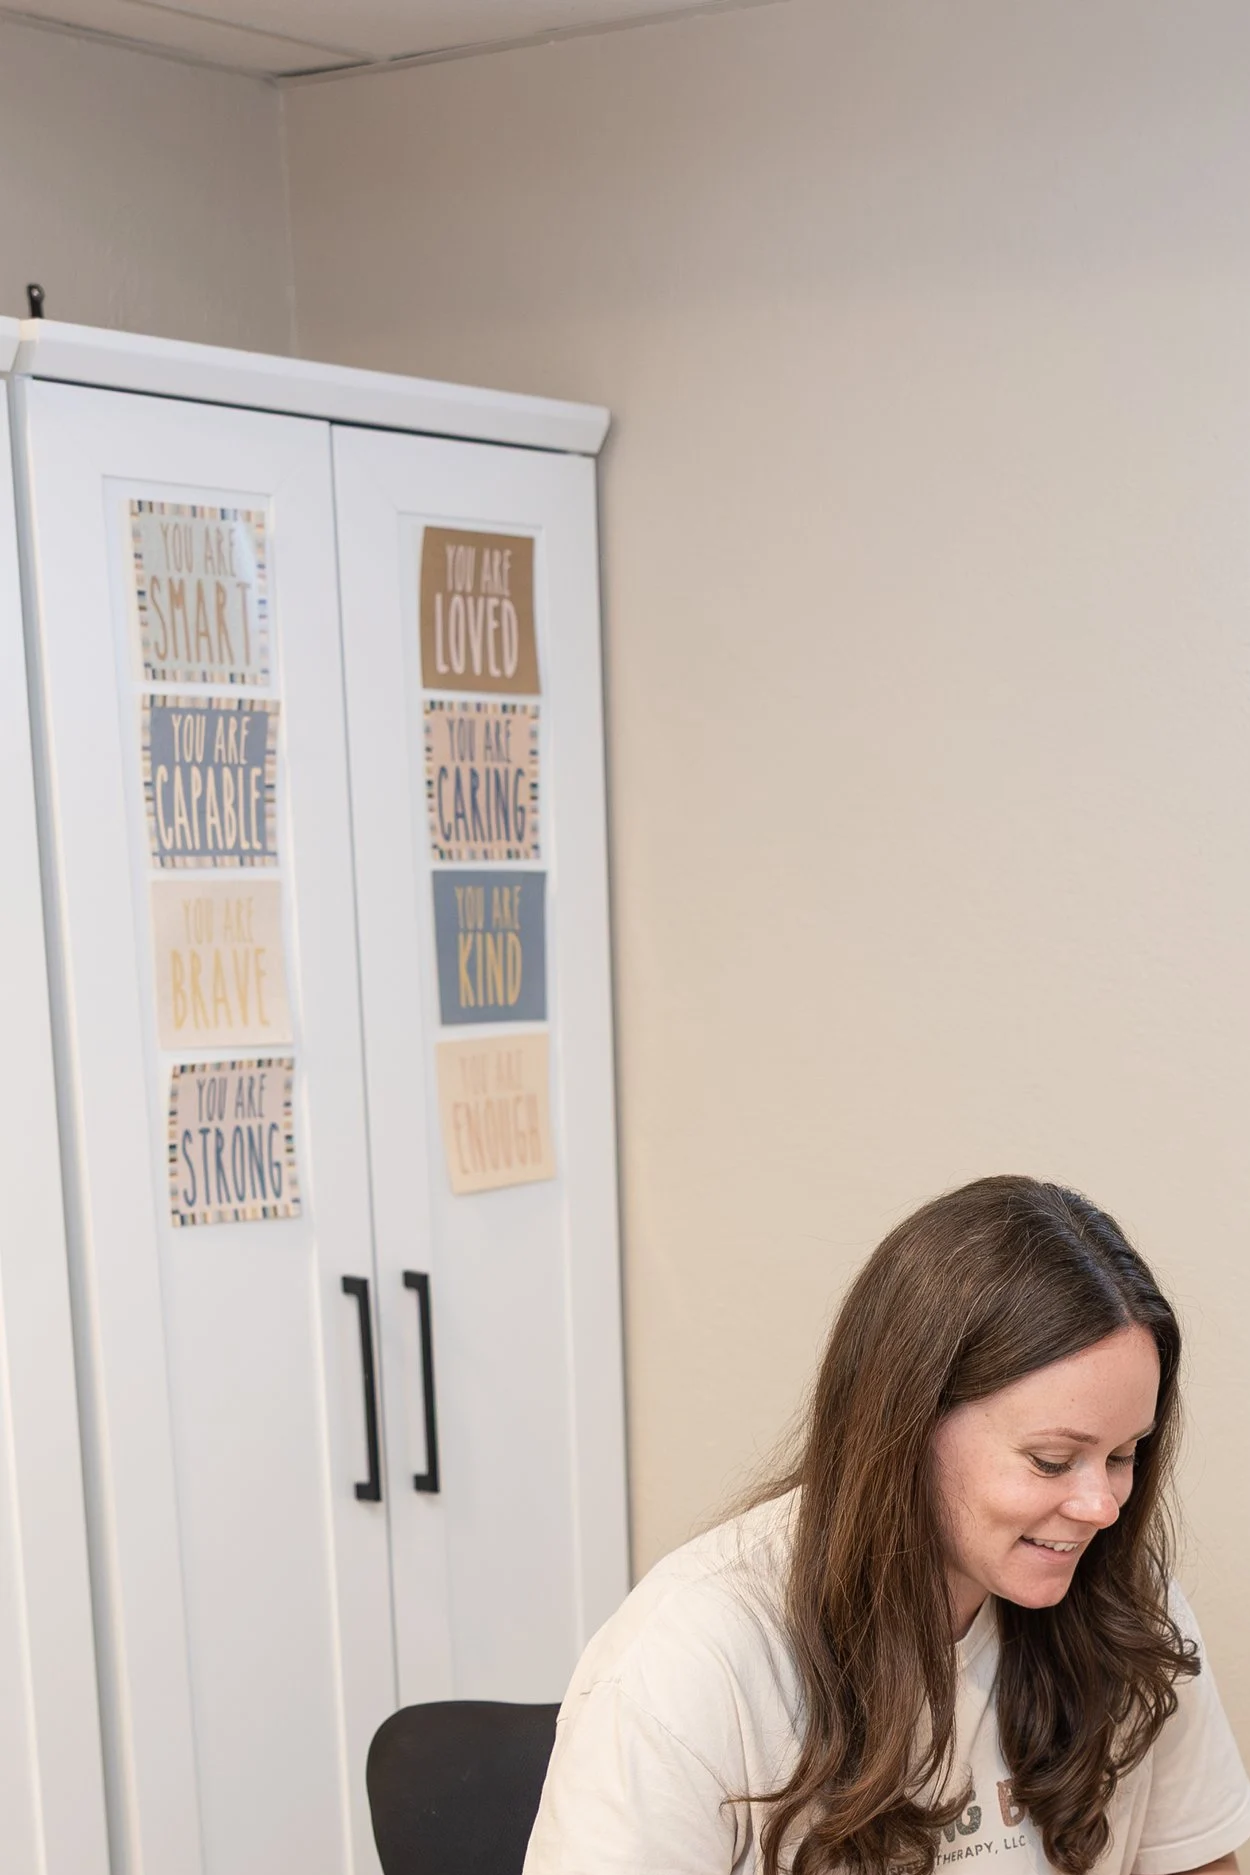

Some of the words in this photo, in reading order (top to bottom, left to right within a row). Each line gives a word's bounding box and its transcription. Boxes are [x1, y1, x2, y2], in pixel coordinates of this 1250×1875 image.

[160, 522, 194, 574] YOU
[204, 527, 238, 578] ARE
[445, 544, 476, 592] YOU
[481, 548, 512, 596] ARE
[150, 574, 251, 667] SMART
[435, 592, 519, 678] LOVED
[172, 713, 206, 764] YOU
[214, 716, 252, 765] ARE
[446, 718, 476, 763] YOU
[484, 718, 512, 764] ARE
[155, 763, 263, 851] CAPABLE
[437, 765, 526, 843] CARING
[182, 898, 213, 945] YOU
[222, 896, 255, 944] ARE
[455, 885, 485, 931] YOU
[492, 885, 522, 931] ARE
[171, 948, 271, 1031] BRAVE
[458, 931, 522, 1008] KIND
[196, 1076, 228, 1123] YOU
[234, 1073, 267, 1119] ARE
[459, 1053, 488, 1095] YOU
[495, 1049, 523, 1090] ARE
[452, 1093, 542, 1176] ENOUGH
[181, 1122, 283, 1208] STRONG
[936, 1841, 998, 1866] THERAPY,
[1003, 1835, 1026, 1850] LLC
